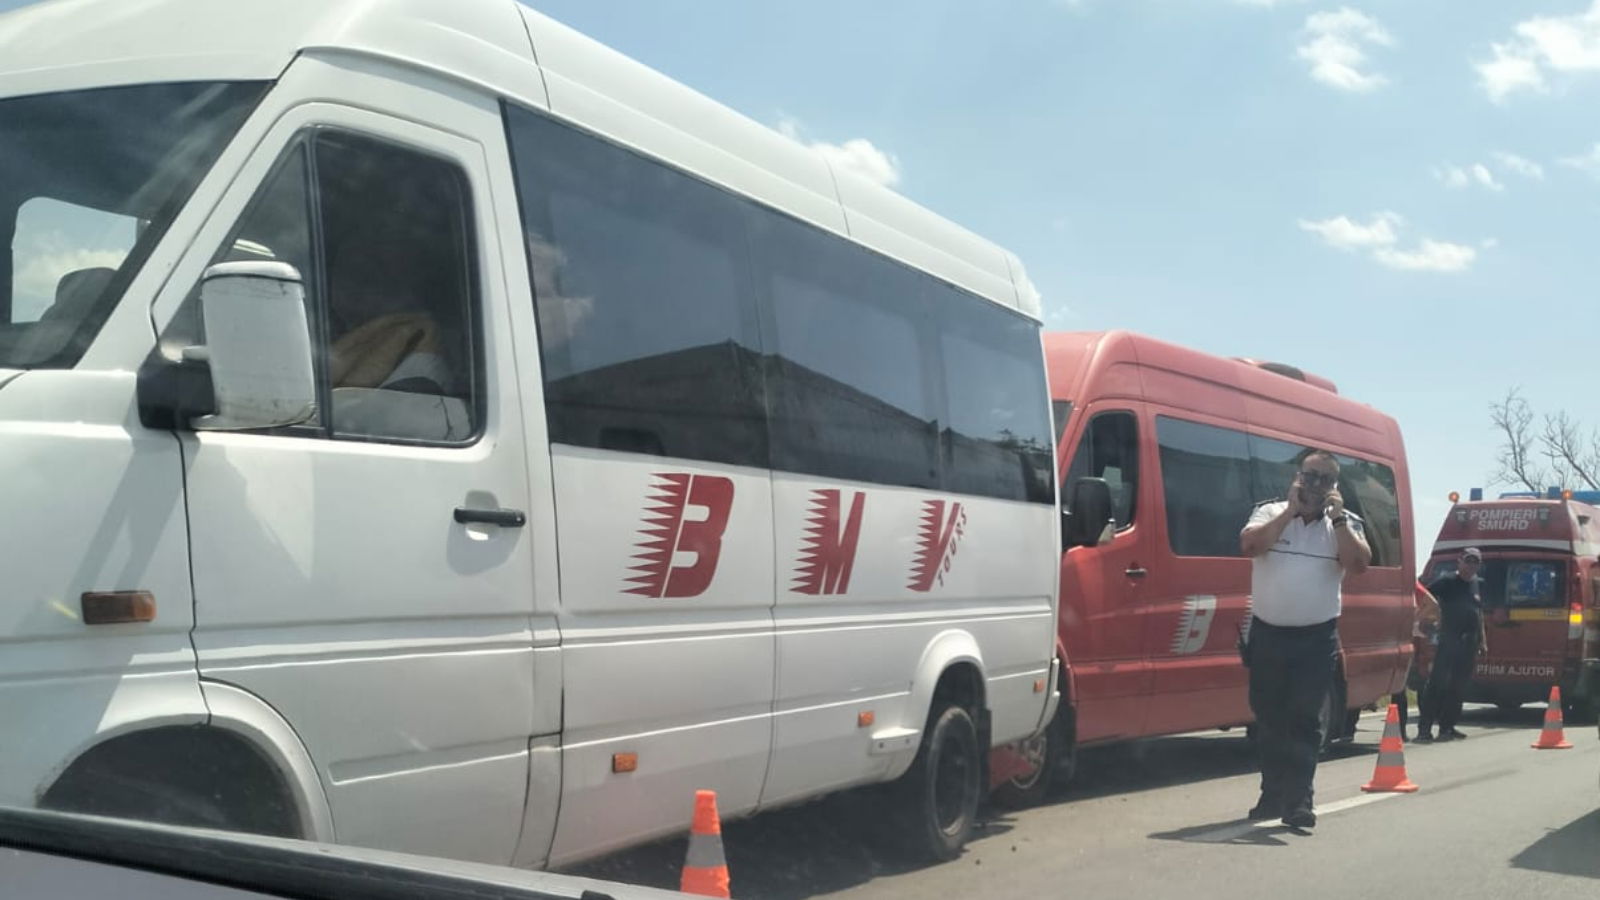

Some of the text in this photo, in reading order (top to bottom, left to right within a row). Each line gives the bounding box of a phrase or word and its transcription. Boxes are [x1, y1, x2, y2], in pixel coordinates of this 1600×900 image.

[1470, 508, 1537, 520] POMPIERI
[1478, 520, 1529, 531] SMURD
[938, 505, 967, 588] TOURS
[1476, 663, 1555, 677] PRIM AJUTOR
